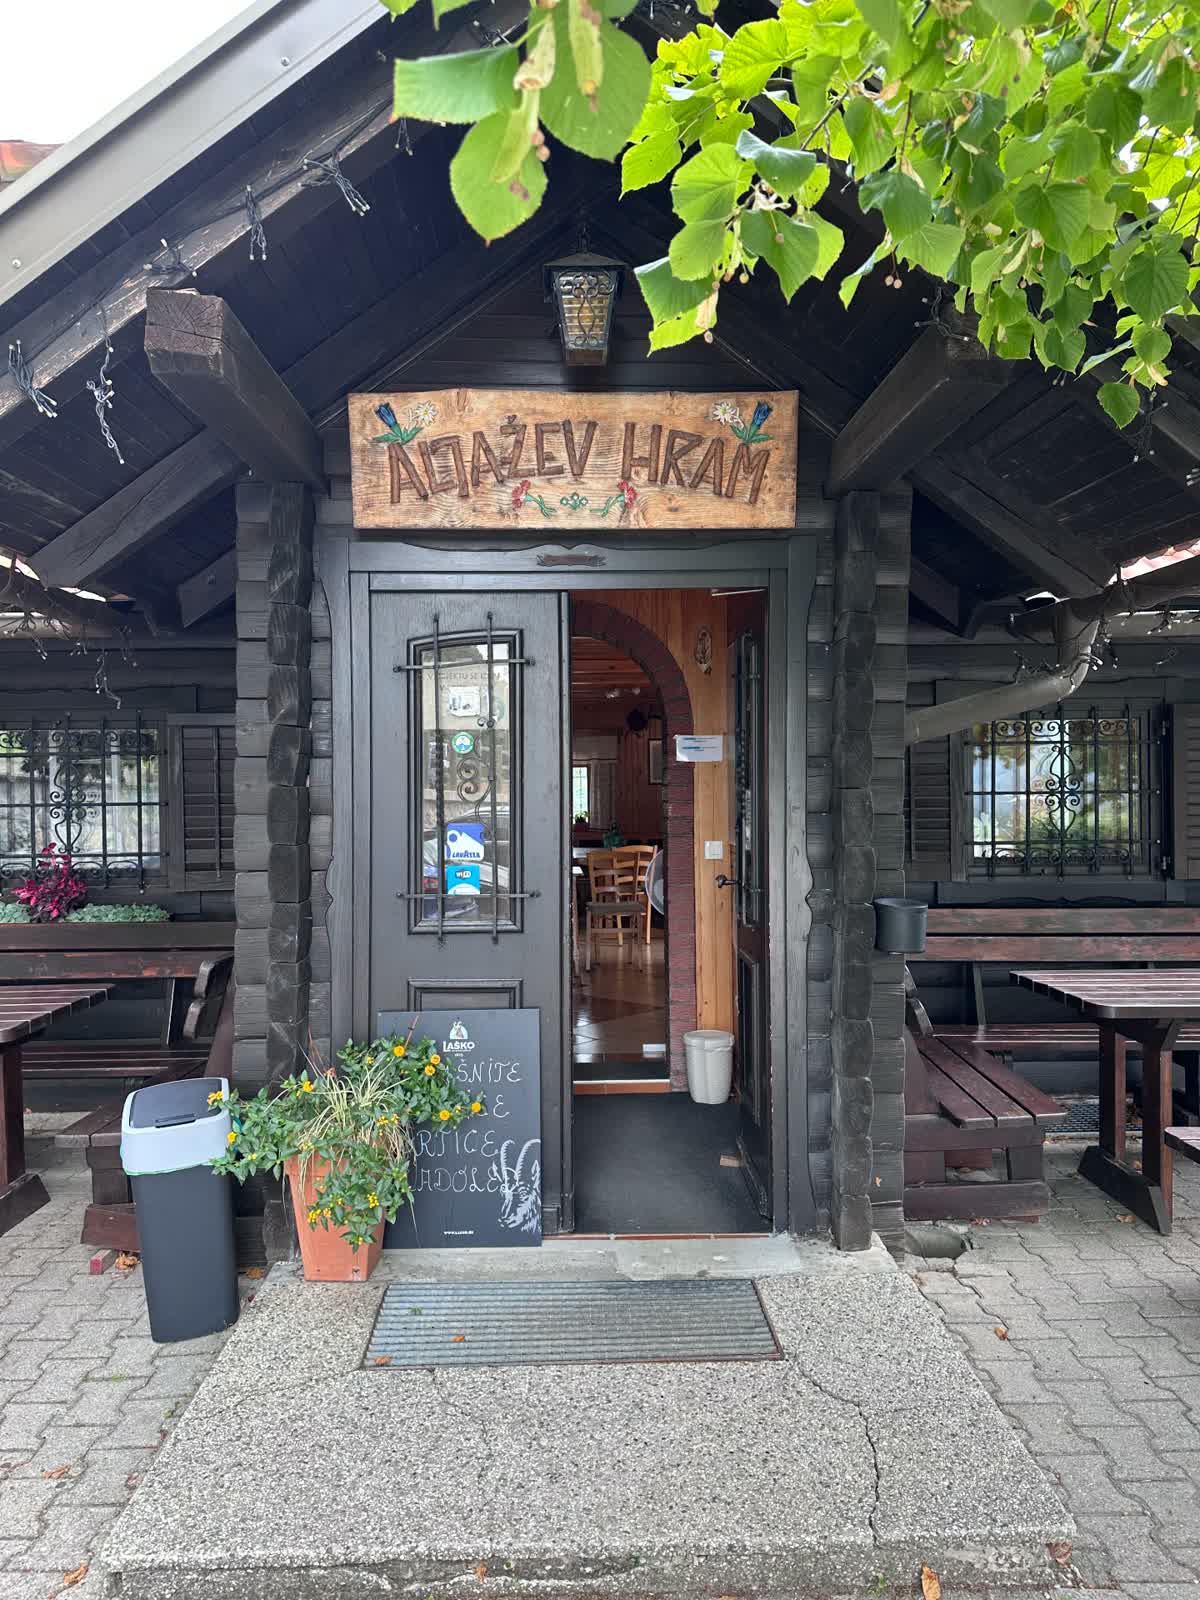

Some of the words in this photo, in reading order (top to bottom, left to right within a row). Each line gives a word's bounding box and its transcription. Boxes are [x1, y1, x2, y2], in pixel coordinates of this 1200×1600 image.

[389, 414, 597, 504] ALJAŽEV
[622, 421, 770, 504] HRAM
[443, 1041, 475, 1052] LAŠKO
